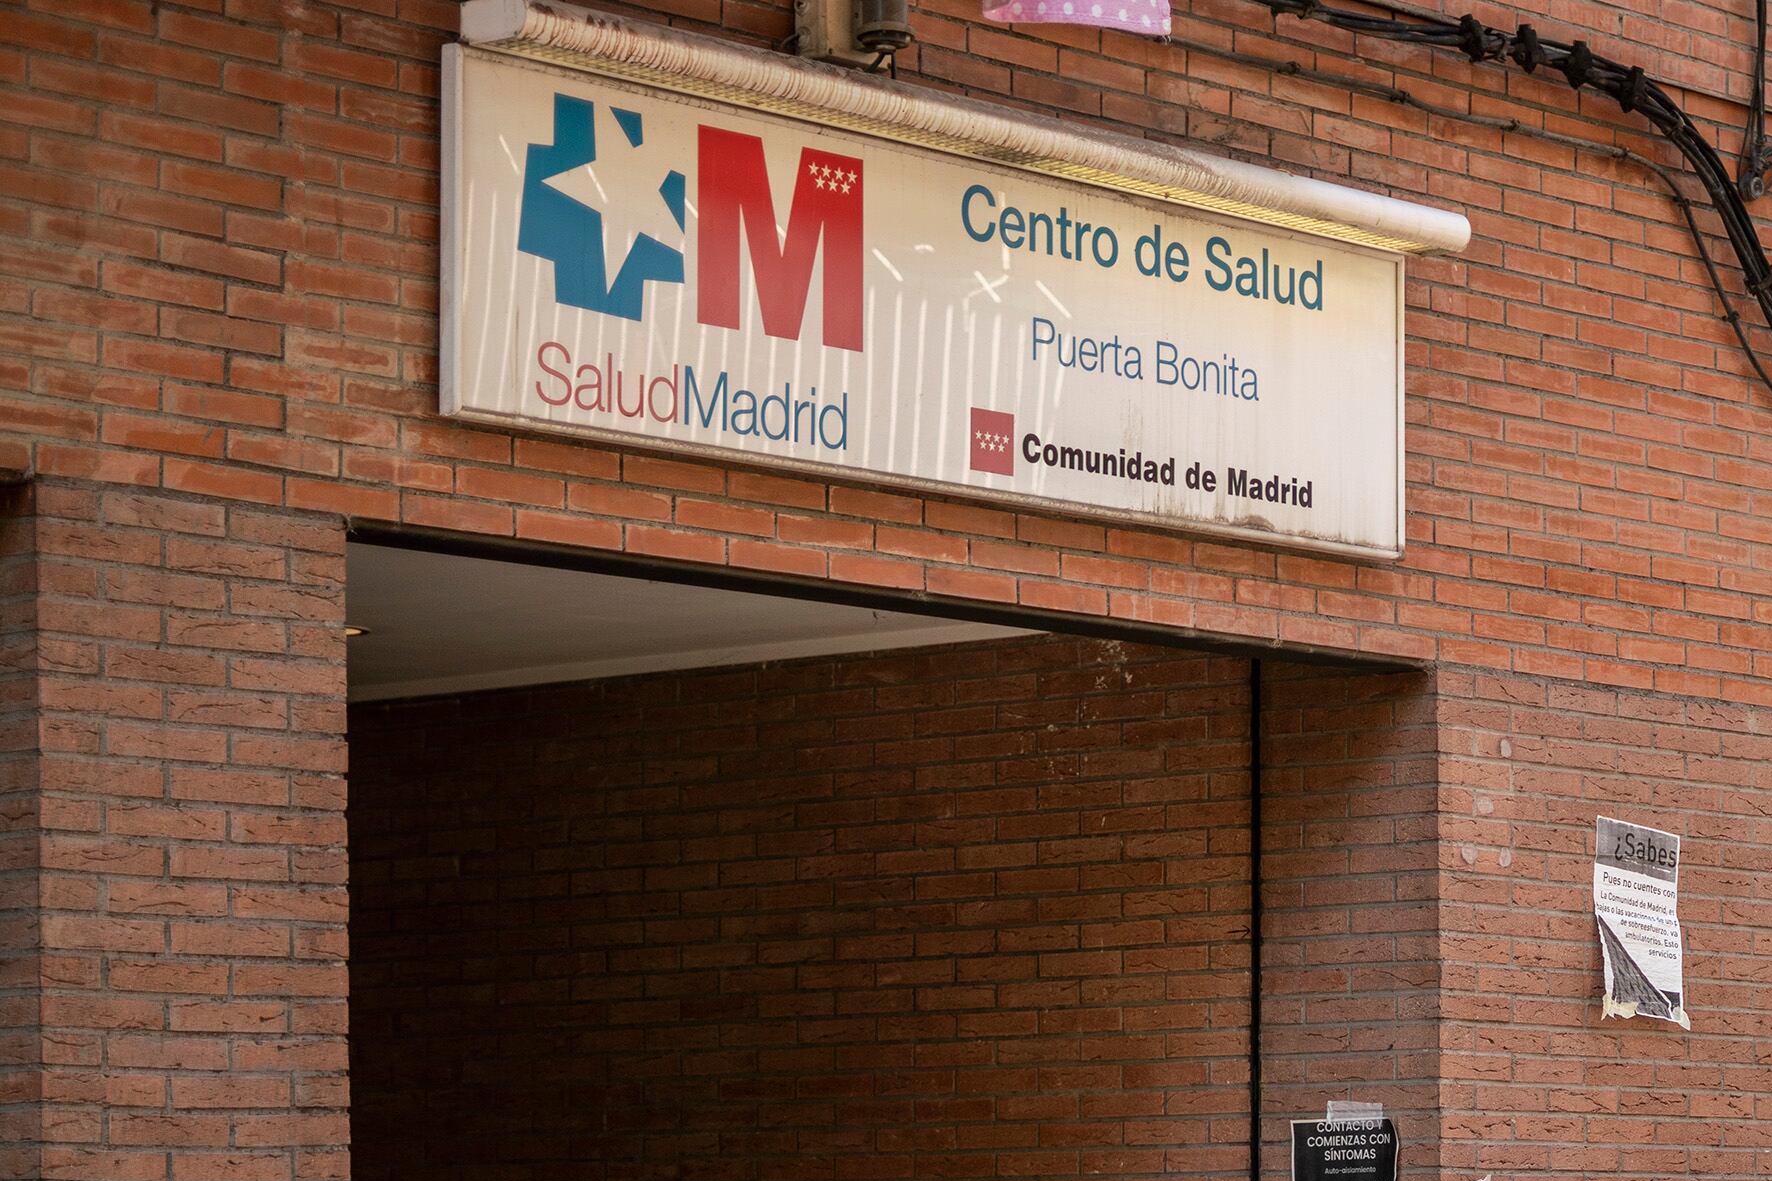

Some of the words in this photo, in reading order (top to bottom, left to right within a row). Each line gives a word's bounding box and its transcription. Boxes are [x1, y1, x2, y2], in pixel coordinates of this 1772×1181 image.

[961, 183, 1120, 269] Centro
[1134, 224, 1190, 282] de
[1205, 236, 1324, 311] Salud
[1032, 316, 1143, 381] Puerta
[1156, 341, 1260, 401] Bonita
[1021, 433, 1175, 487] Comunidad
[1185, 461, 1217, 493] de
[1227, 467, 1313, 509] Madrid
[1615, 833, 1677, 868] ¿Sabes
[1603, 872, 1621, 887] Pues
[1622, 879, 1632, 889] no
[1633, 881, 1661, 896] cuentes
[1663, 889, 1676, 900] con
[1600, 890, 1607, 900] La
[1608, 892, 1639, 907] Comunidad
[1639, 899, 1646, 909] de
[1615, 907, 1624, 917] las
[1664, 939, 1679, 949] Esto
[1648, 949, 1677, 960] servicios
[1316, 1120, 1375, 1133] CONTACTO
[1376, 1119, 1383, 1130] Y
[1307, 1134, 1367, 1148] COMIENZAS
[1369, 1133, 1391, 1145] CON
[1324, 1147, 1376, 1161] SÍNTOMAS
[1324, 1166, 1377, 1175] Auto-aislamiento
